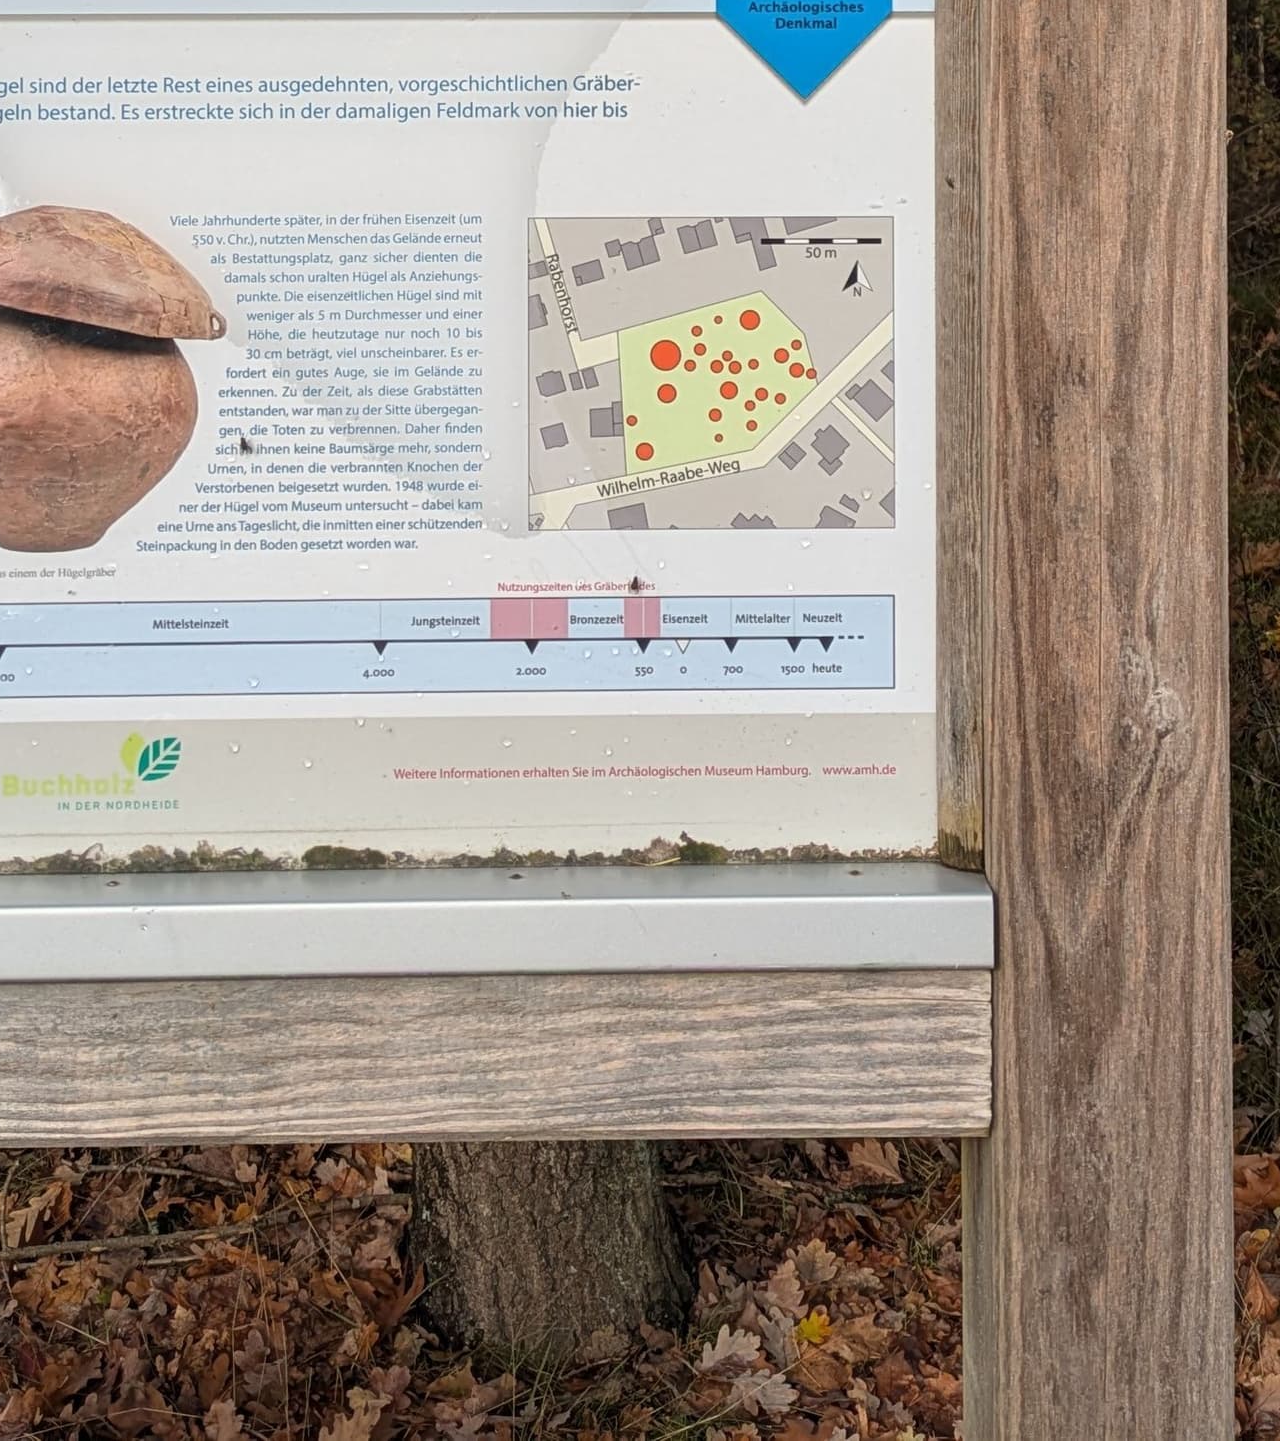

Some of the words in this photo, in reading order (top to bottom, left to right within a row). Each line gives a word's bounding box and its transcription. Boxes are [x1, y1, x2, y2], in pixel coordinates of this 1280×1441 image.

[748, 0, 864, 18] Archäologisches
[775, 16, 836, 29] Denkmal
[29, 76, 66, 93] sind
[72, 76, 102, 93] der
[108, 76, 158, 93] letzte
[163, 77, 201, 93] Rest
[206, 77, 253, 93] eines
[258, 75, 393, 96] ausgedehnten,
[398, 74, 567, 96] vorgeschichtlichen
[572, 73, 640, 91] Gräber-
[38, 103, 115, 120] bestand.
[121, 103, 140, 120] Es
[144, 102, 234, 119] erstreckte
[238, 102, 273, 119] sich
[279, 103, 295, 118] in
[300, 102, 331, 119] der
[335, 101, 430, 123] damaligen
[437, 101, 520, 118] Feldmark
[524, 105, 557, 118] von
[563, 101, 598, 118] hier
[602, 101, 628, 118] bis
[169, 214, 198, 226] Viele
[201, 215, 281, 226] Jahrhunderte
[284, 214, 322, 228] später,
[326, 214, 336, 225] in
[339, 213, 360, 225] der
[362, 213, 402, 225] frühen
[404, 213, 456, 225] Eisenzeit
[458, 213, 482, 225] (um
[192, 235, 214, 245] 550
[216, 236, 226, 245] v.
[227, 230, 257, 246] Chr.),
[259, 234, 304, 245] nutzten
[307, 232, 368, 244] Menschen
[370, 232, 390, 244] das
[392, 232, 442, 243] Gelände
[443, 233, 482, 244] erneut
[210, 252, 226, 264] als
[232, 252, 333, 266] Bestattungsplatz,
[338, 254, 368, 266] ganz
[372, 251, 408, 262] sicher
[412, 250, 458, 262] dienten
[464, 250, 482, 262] die
[805, 246, 822, 258] 50
[824, 249, 837, 258] m
[224, 271, 266, 283] damals
[269, 271, 304, 283] schon
[307, 270, 349, 282] uralten
[352, 270, 387, 285] Hügel
[390, 270, 406, 282] als
[409, 269, 482, 284] Anziehungs-
[545, 254, 578, 334] Rabenhorst
[853, 286, 862, 296] N
[596, 458, 741, 498] Wilhelm-Raabe-Weg
[8, 568, 37, 578] einem
[39, 567, 56, 578] der
[57, 567, 116, 580] Hügelgräber
[497, 582, 573, 594] Nutzungszeiten
[594, 581, 656, 592] Gräberfdes
[152, 618, 229, 629] Mittelsteinzeit
[410, 615, 480, 629] Jungsteinzeit
[570, 614, 624, 624] Bronzezeit
[662, 613, 708, 624] Eisenzeit
[735, 613, 790, 624] Mittelalter
[802, 612, 842, 622] Neuzeit
[362, 668, 395, 679] 4.000
[516, 667, 546, 676] 2.000
[634, 666, 654, 677] 550
[679, 666, 687, 674] 0
[722, 665, 743, 676] 700
[780, 665, 805, 676] 1500
[812, 662, 842, 673] heute
[393, 768, 436, 779] Weitere
[439, 766, 520, 778] Informationen
[522, 766, 570, 778] erhalten
[572, 766, 589, 777] Sie
[591, 766, 606, 777] im
[608, 765, 702, 779] Archäologischen
[704, 765, 753, 776] Museum
[756, 764, 811, 778] Hamburg.
[822, 763, 896, 775] www.amh.de
[2, 774, 135, 796] Buchholz
[57, 801, 70, 810] IN
[75, 801, 100, 811] DER
[105, 799, 179, 810] NORDHEIDE
